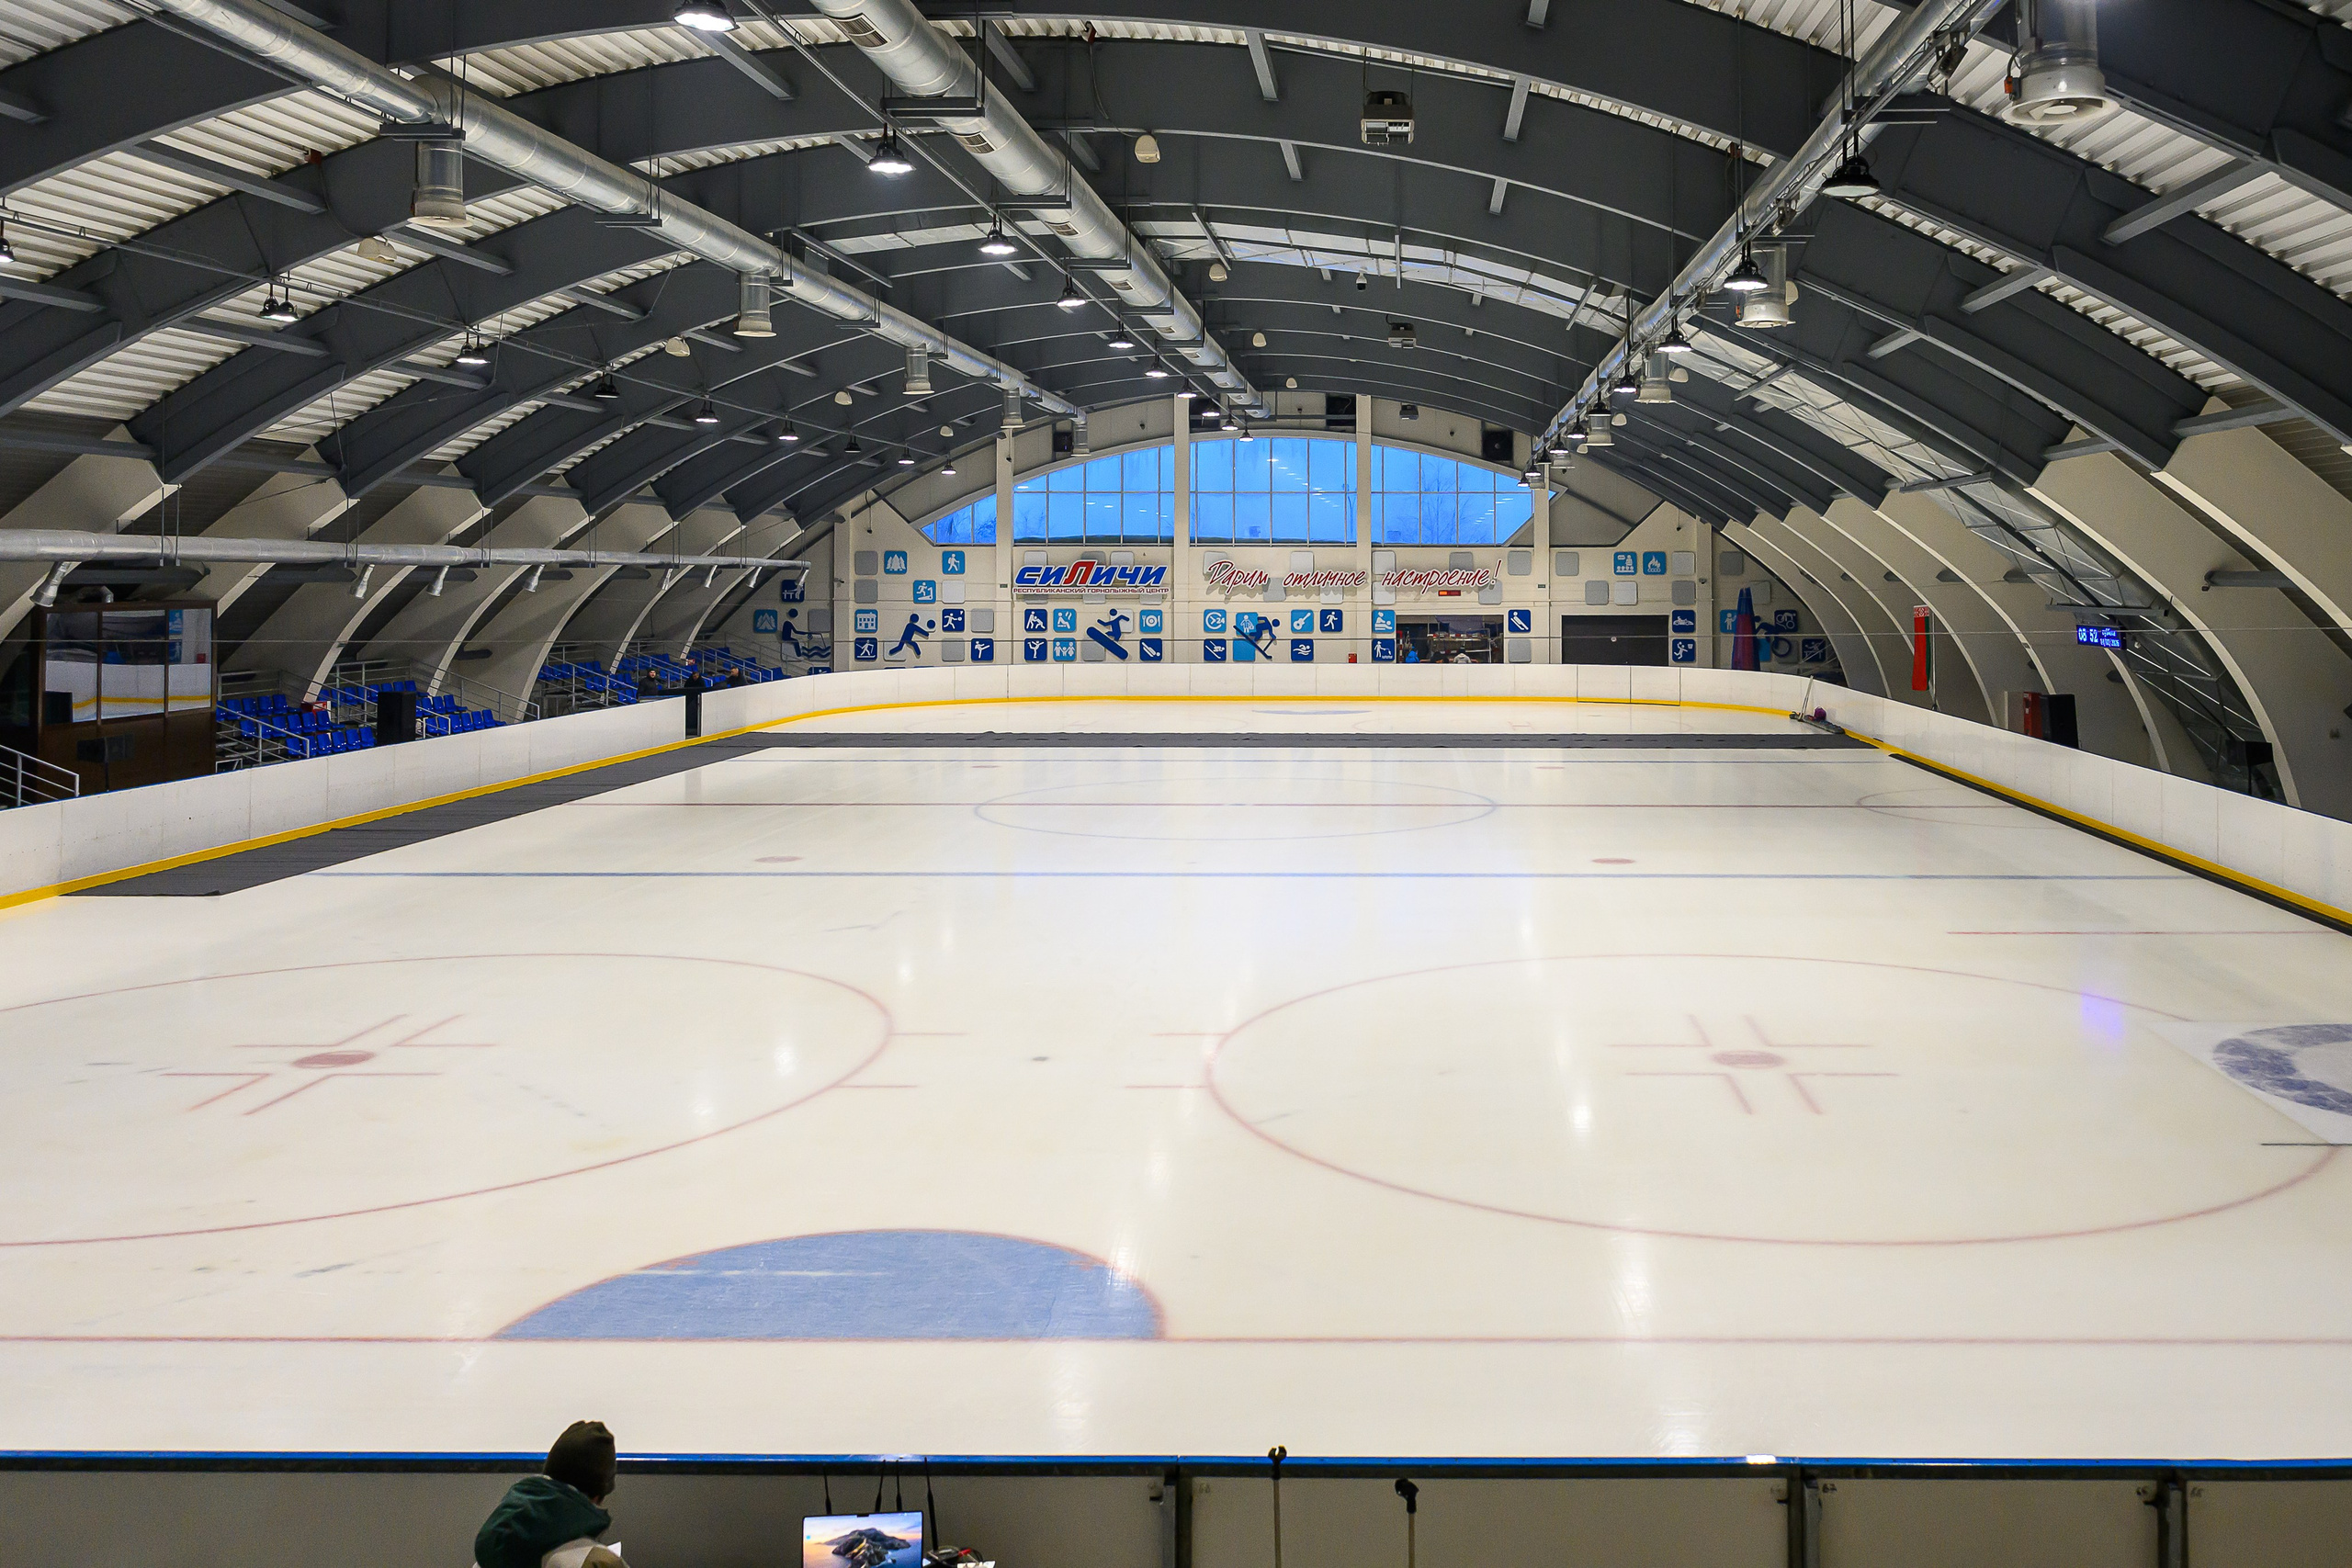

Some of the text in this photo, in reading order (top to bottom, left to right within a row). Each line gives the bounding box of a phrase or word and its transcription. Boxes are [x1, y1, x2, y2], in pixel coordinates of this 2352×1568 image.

[1207, 558, 1502, 595] Дарим отличное настроение!
